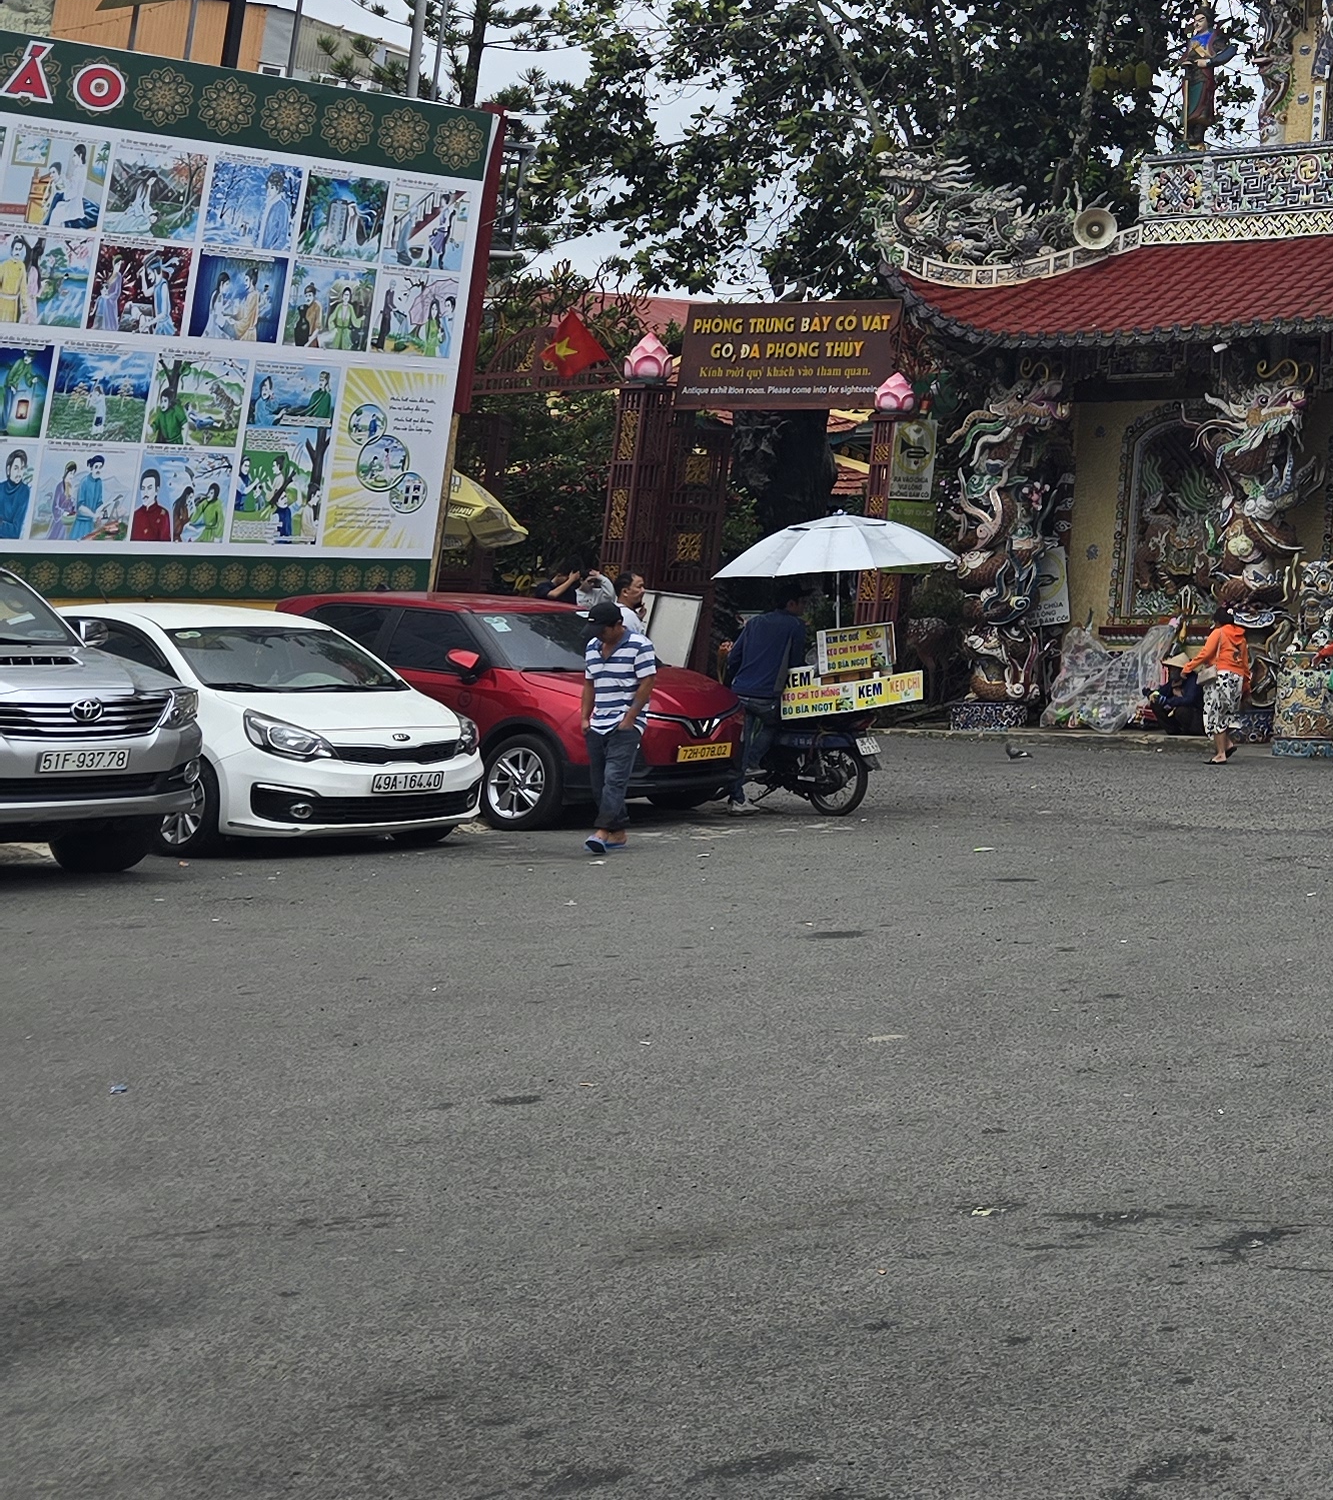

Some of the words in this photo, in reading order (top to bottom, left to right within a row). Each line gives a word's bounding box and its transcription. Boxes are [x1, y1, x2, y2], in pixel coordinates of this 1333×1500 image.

[693, 314, 743, 333] PHÒNG
[800, 312, 833, 332] BÀY
[766, 341, 819, 359] PHONG
[700, 367, 723, 377] Kính
[766, 366, 794, 377] khách
[817, 366, 841, 376] tham
[682, 386, 710, 396] Antique
[767, 385, 790, 394] Please
[813, 385, 827, 393] into
[828, 385, 839, 393] for
[858, 682, 882, 699] KEM
[42, 751, 126, 770] 51F-937.78
[373, 773, 441, 790] 49A-164.40
